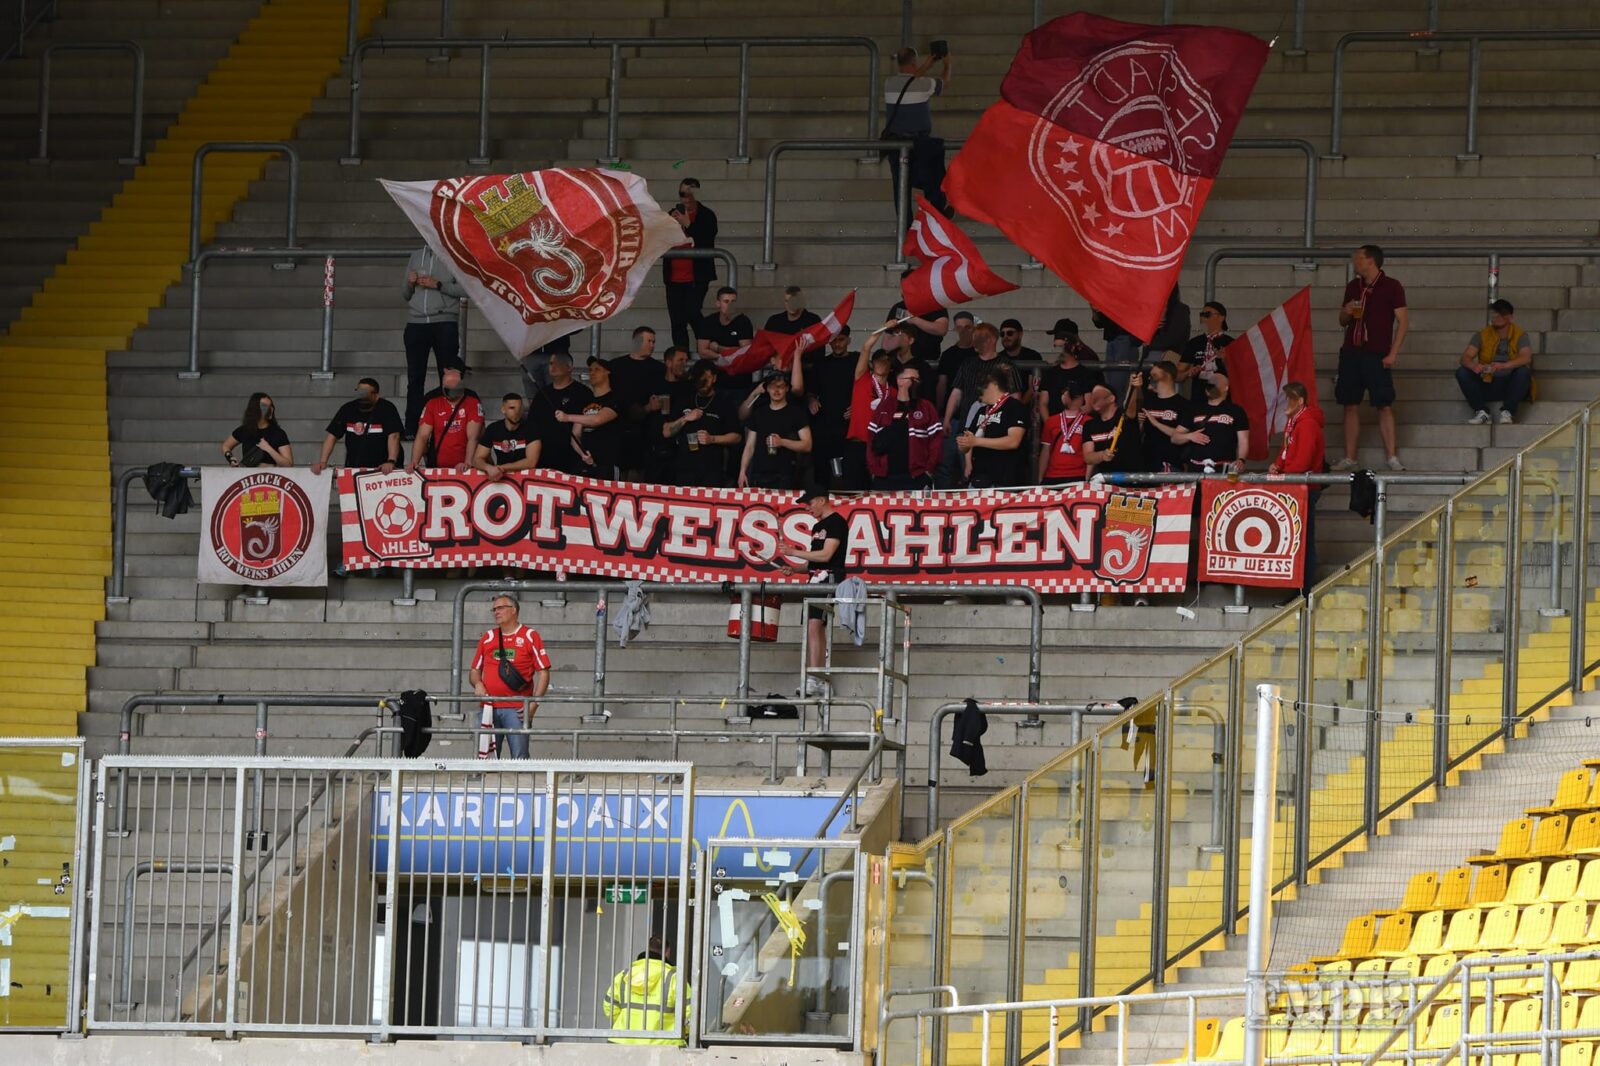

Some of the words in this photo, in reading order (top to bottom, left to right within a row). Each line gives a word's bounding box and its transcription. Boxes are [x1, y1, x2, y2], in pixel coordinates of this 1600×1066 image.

[240, 473, 281, 491] BLOCK
[284, 480, 295, 492] G
[365, 481, 384, 492] ROT
[385, 477, 413, 489] WEISS
[1225, 497, 1287, 522] KOLLEKTIV
[423, 482, 573, 541] ROT
[584, 490, 818, 565] WEISS
[845, 506, 1098, 568] AHLEN
[382, 540, 430, 554] AHLEN
[215, 546, 236, 569] ROT
[235, 564, 270, 580] WEISS
[270, 547, 304, 577] AHLEN
[1209, 555, 1237, 569] ROT
[1244, 557, 1292, 573] WEISS
[378, 794, 670, 830] KARDIOAIX
